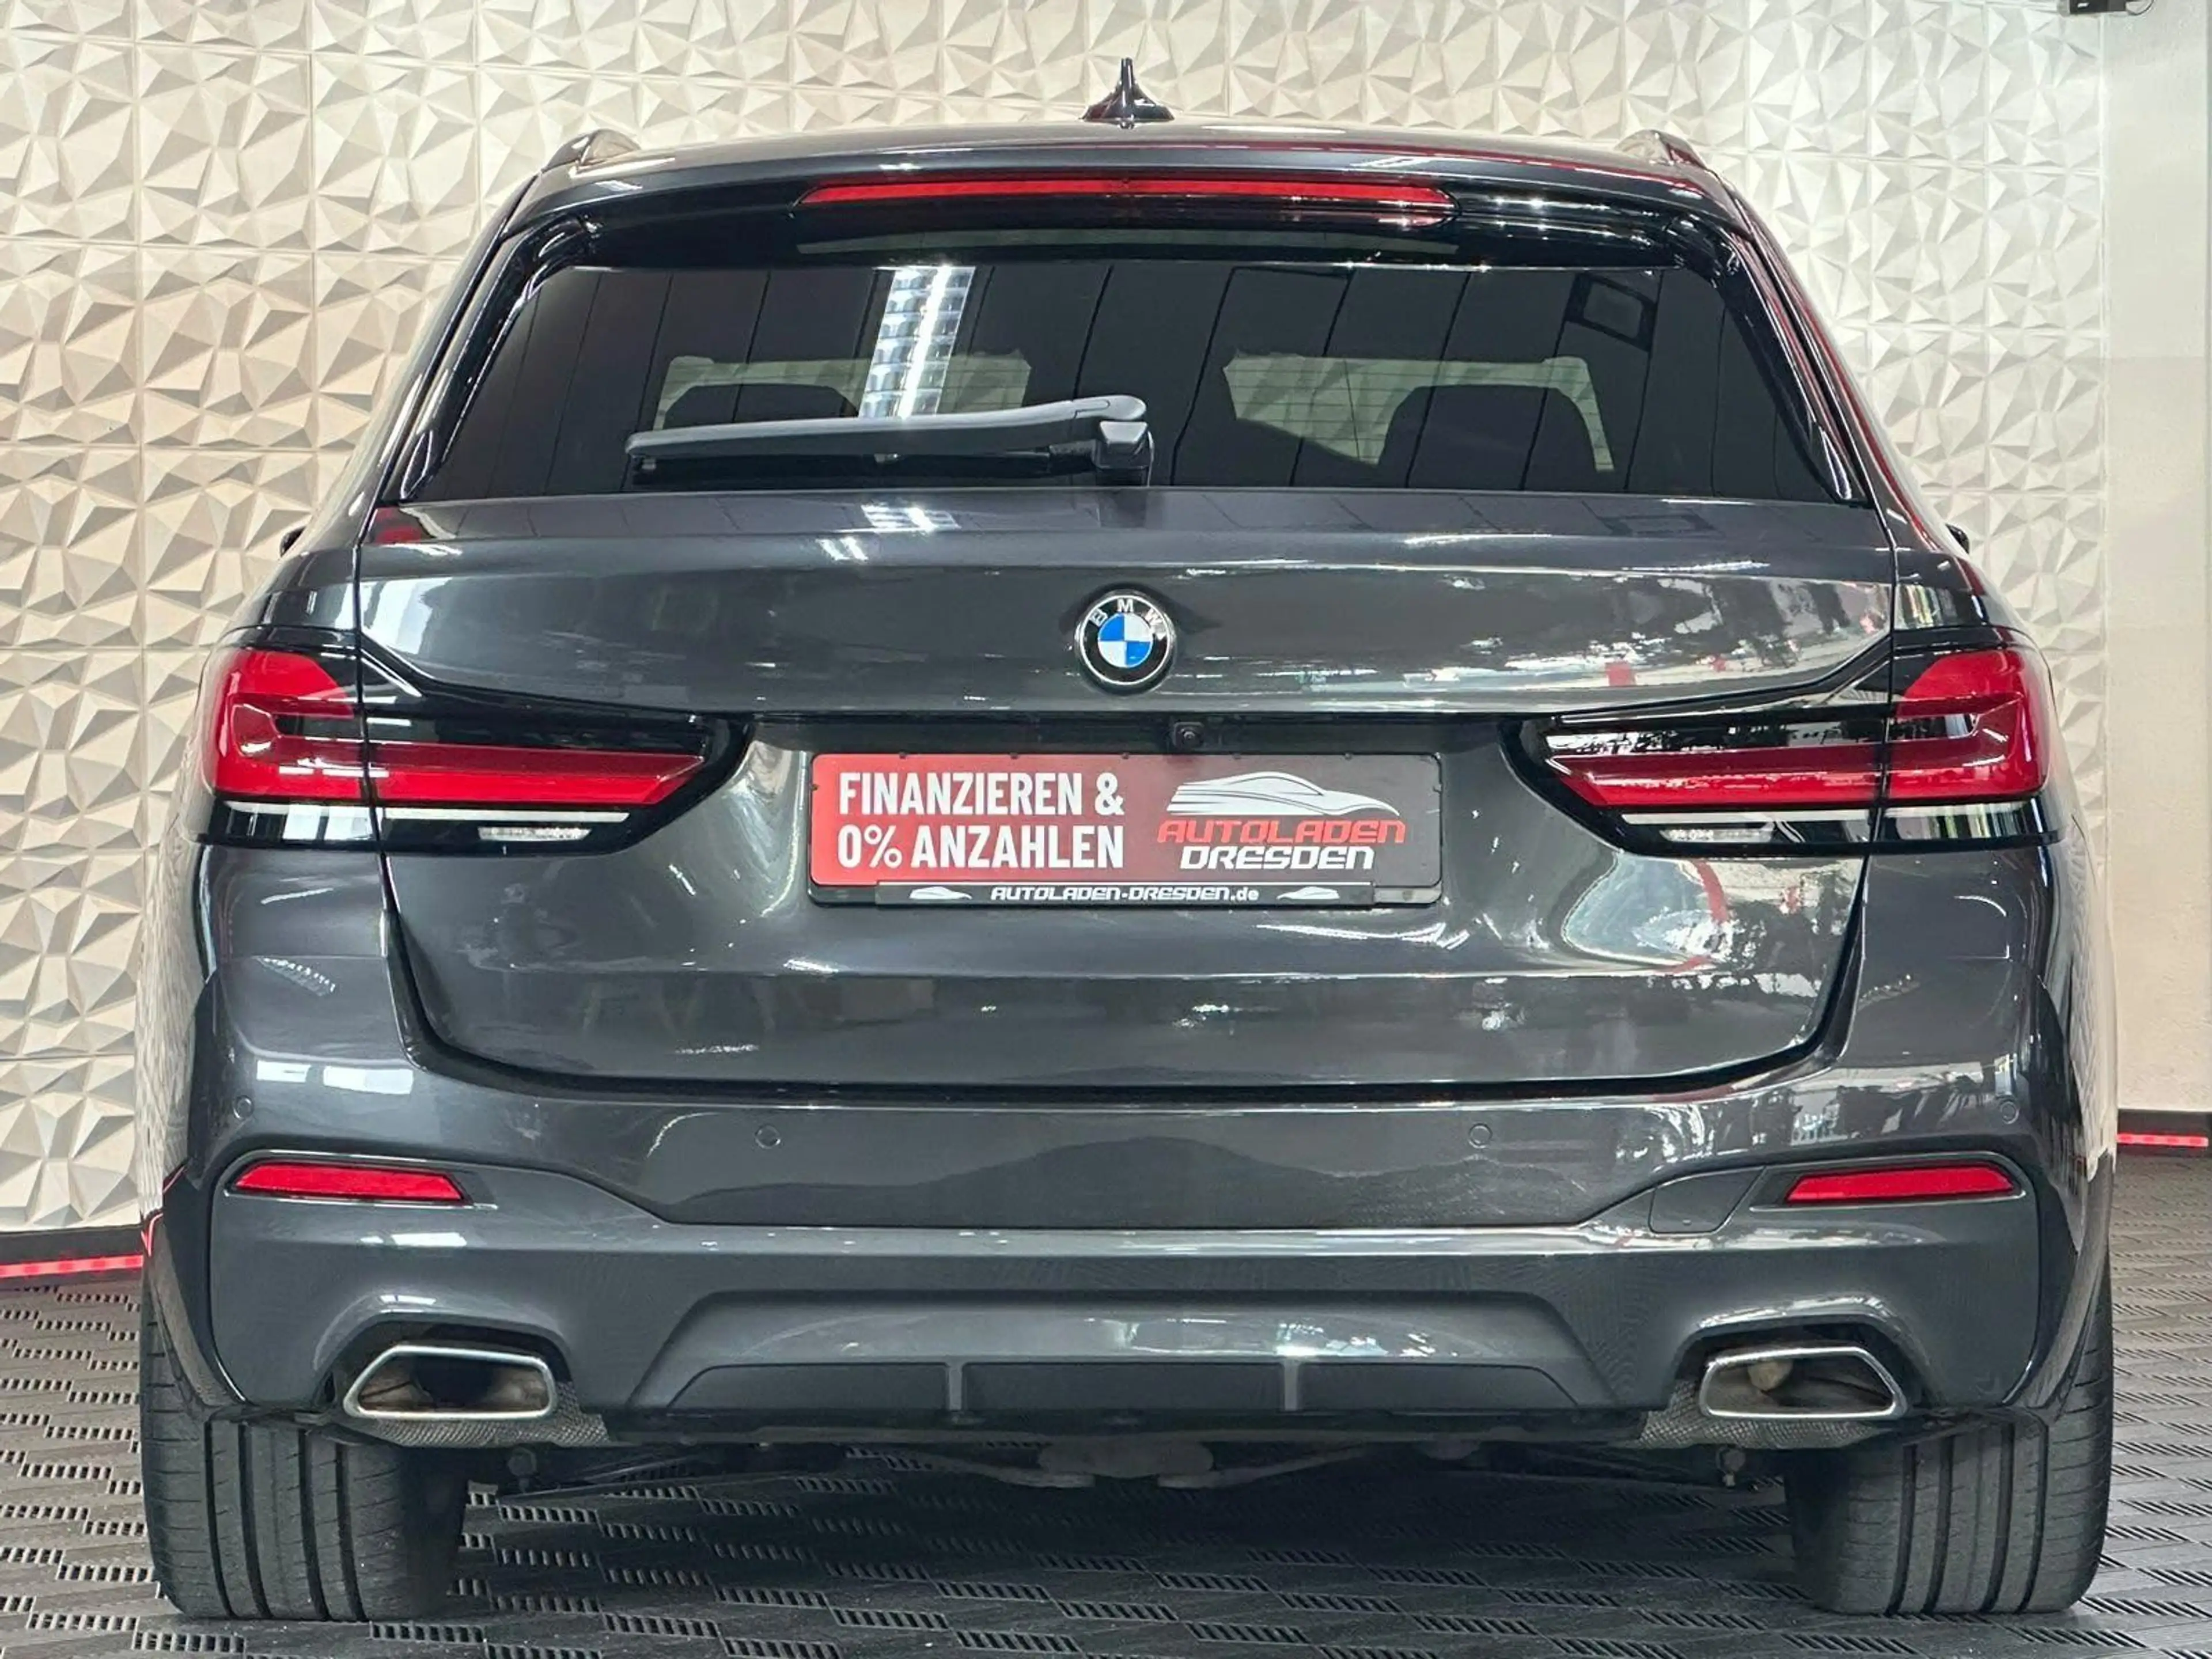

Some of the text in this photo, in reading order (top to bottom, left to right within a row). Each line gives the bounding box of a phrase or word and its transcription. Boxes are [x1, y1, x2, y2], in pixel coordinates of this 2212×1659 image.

[1089, 599, 1167, 641] BMW
[839, 772, 1124, 815] FINANZIEREN &
[838, 824, 1123, 869] 0% ANZAHLEN
[1157, 820, 1406, 843] AUTOLADEN
[1180, 846, 1374, 870] DRESDEN
